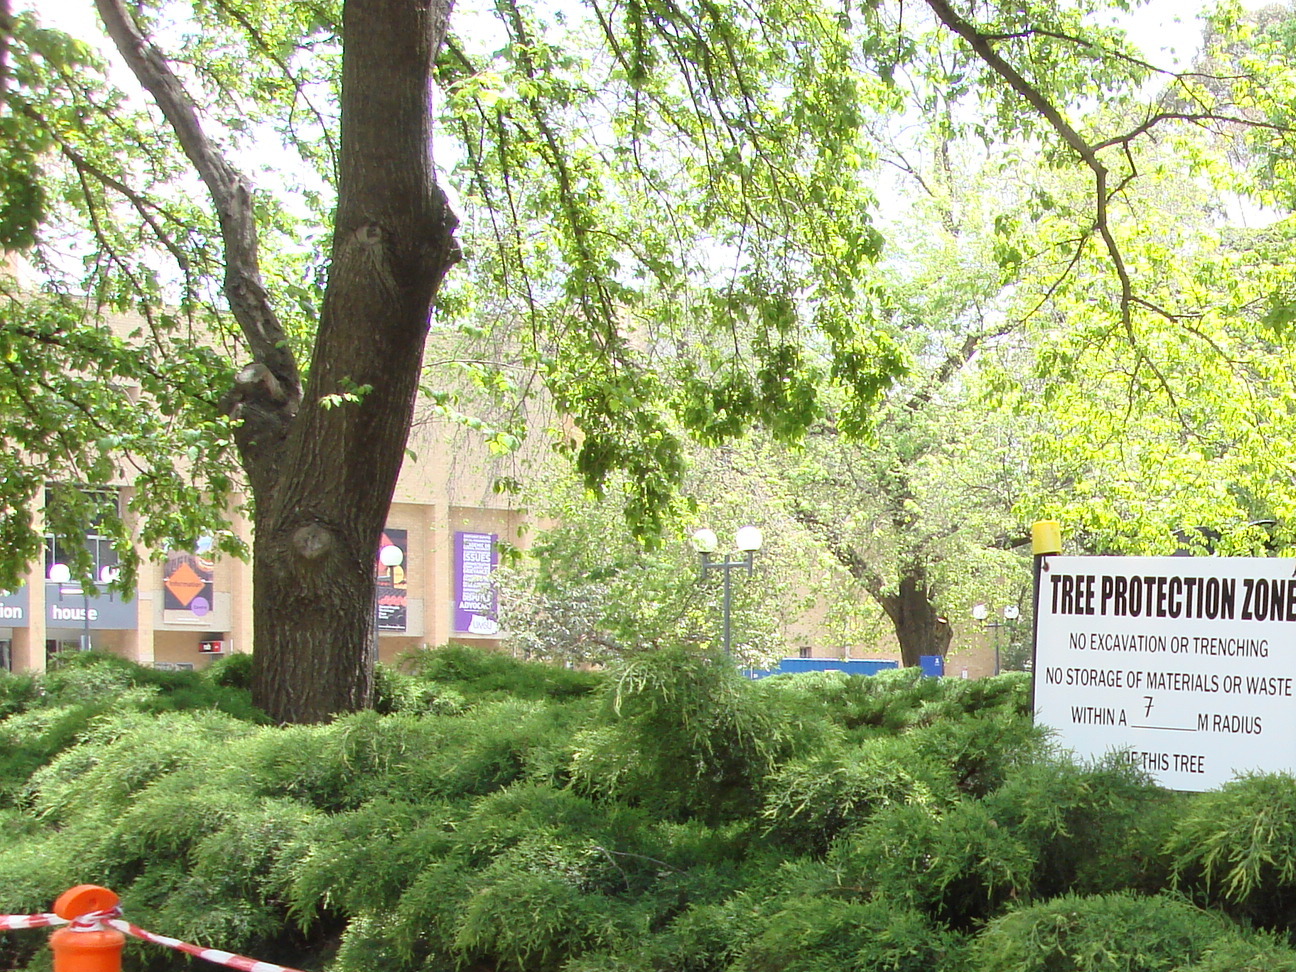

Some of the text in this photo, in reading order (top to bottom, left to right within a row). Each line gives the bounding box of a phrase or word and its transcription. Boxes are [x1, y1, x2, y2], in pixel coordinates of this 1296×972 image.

[1050, 574, 1096, 616] TREE
[1100, 575, 1236, 620] PROTECTION
[52, 604, 98, 621] house
[1069, 632, 1269, 658] NO EXCAVATION OR TRENCHING
[1045, 667, 1293, 697] NO STORAGE OF MATERIALS OR WASTE
[1071, 696, 1262, 735] WITHIN A 7 M RADIUS
[1141, 751, 1170, 771] THIS
[1173, 753, 1206, 774] TREE
